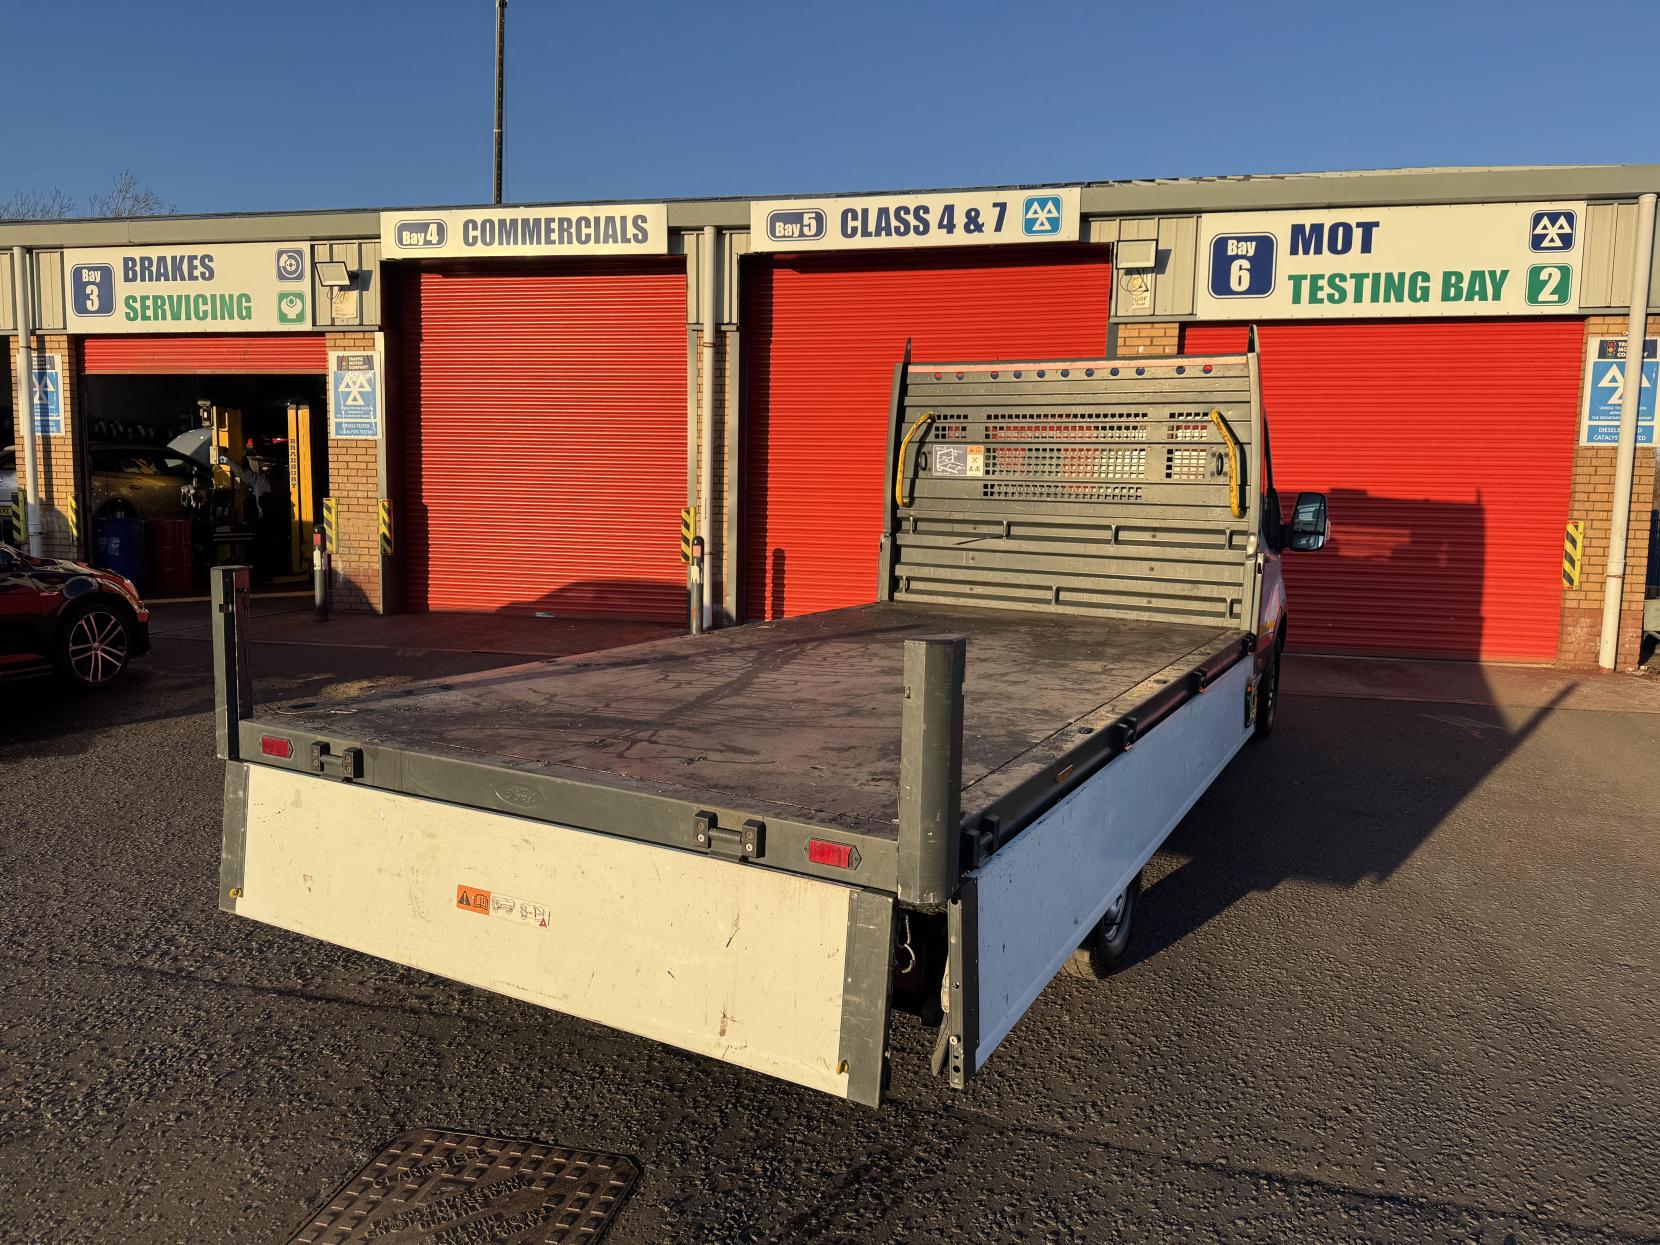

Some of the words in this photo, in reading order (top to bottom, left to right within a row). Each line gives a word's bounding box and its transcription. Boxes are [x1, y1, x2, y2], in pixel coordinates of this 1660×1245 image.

[402, 231, 425, 246] Bay
[426, 223, 439, 244] 4
[463, 214, 649, 247] COMMERCIALS
[775, 221, 800, 238] Bay
[803, 212, 817, 236] 5
[840, 204, 931, 239] CLASS
[937, 203, 957, 235] 4
[963, 207, 985, 234] &
[992, 201, 1008, 233] 7
[1227, 239, 1257, 258] Bay
[1289, 220, 1381, 257] MOT
[81, 269, 101, 283] Bay
[122, 253, 215, 283] BRAKES
[1229, 258, 1251, 292] 6
[85, 285, 100, 312] 3
[1287, 270, 1431, 305] TESTING
[1440, 269, 1510, 303] BAY
[1537, 266, 1562, 303] 2
[123, 292, 253, 322] SERVICING
